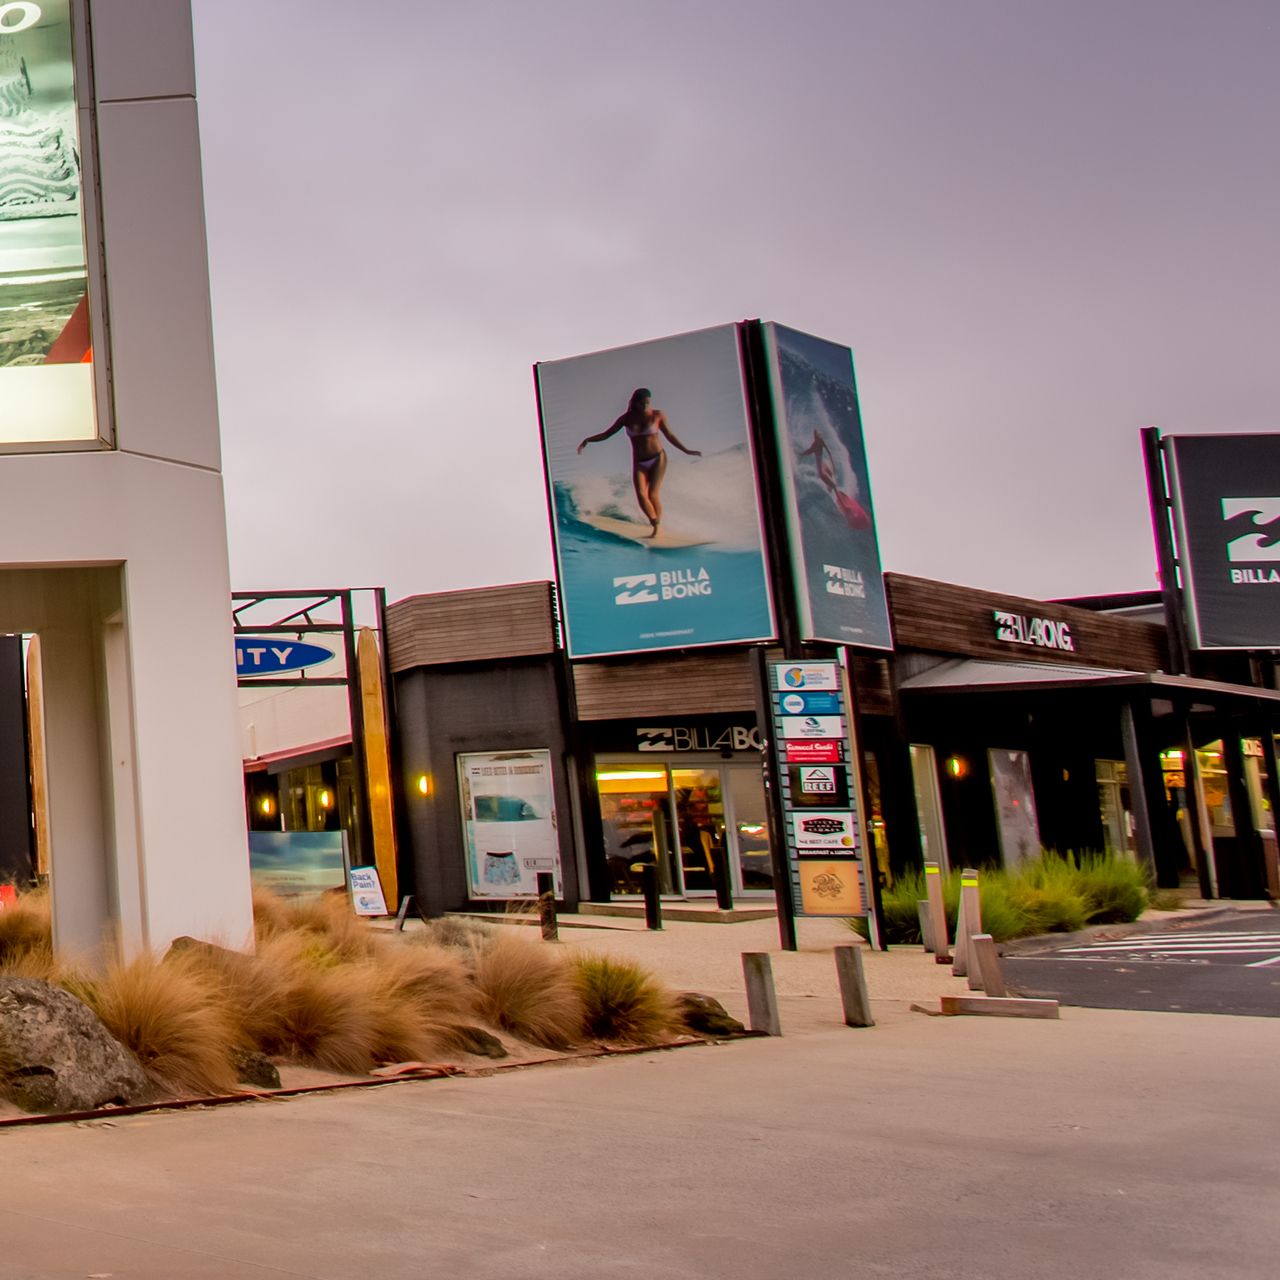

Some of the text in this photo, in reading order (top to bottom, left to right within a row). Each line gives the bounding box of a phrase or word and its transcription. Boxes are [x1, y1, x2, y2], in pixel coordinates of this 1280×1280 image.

[660, 567, 710, 586] BILLA
[661, 581, 712, 600] BONG
[804, 782, 833, 791] REEF
[352, 872, 372, 881] Back
[353, 881, 375, 889] Pain?
